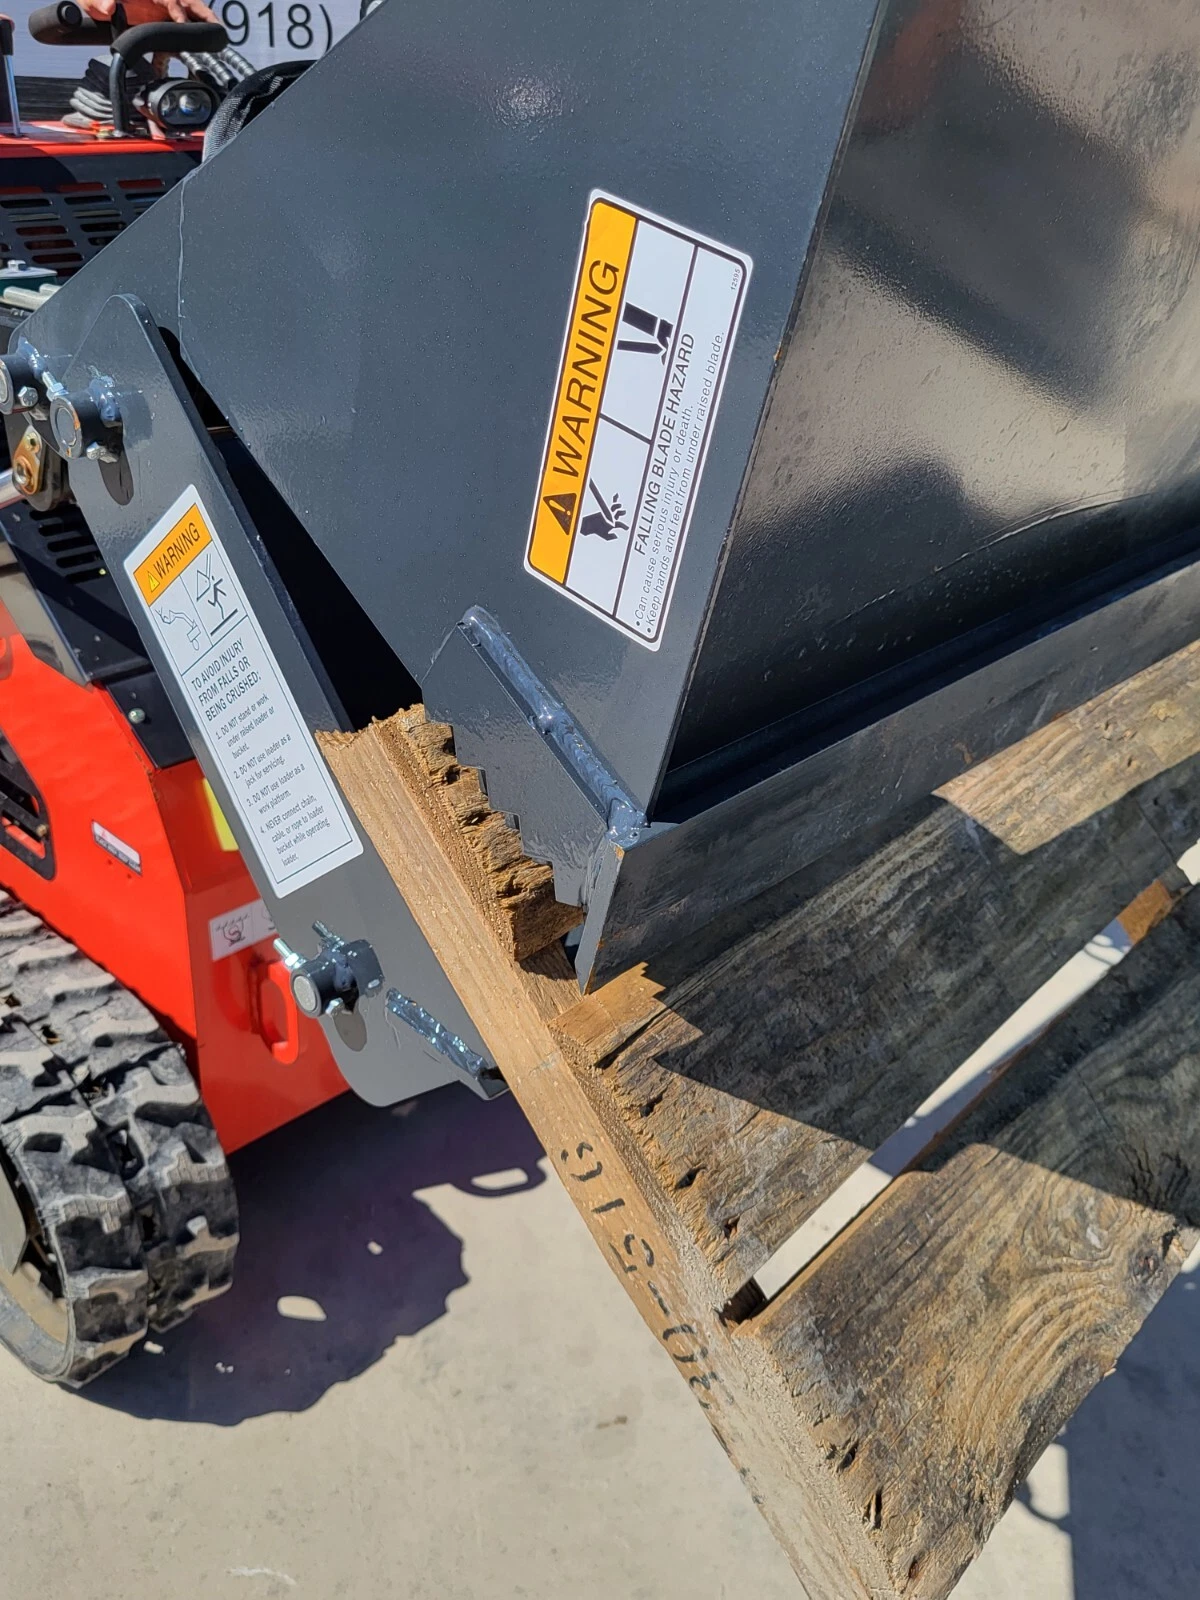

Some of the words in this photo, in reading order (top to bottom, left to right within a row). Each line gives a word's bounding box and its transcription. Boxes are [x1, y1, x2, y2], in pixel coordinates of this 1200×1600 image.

[208, 0, 332, 51] 918)
[730, 267, 740, 290] 12595
[552, 259, 619, 477] WARNING
[705, 332, 724, 374] blade.
[696, 377, 712, 421] raised
[675, 405, 693, 445] death.
[685, 423, 701, 463] under
[634, 481, 660, 555] FALLING
[651, 415, 675, 477] BLADE
[665, 333, 694, 413] HAZARD
[672, 448, 682, 463] or
[660, 466, 679, 505] injury
[675, 467, 691, 498] from
[651, 507, 668, 554] serious
[669, 500, 683, 525] feet
[153, 522, 200, 578] WARNING
[664, 527, 676, 552] and
[642, 557, 656, 593] cause
[653, 555, 670, 593] hands
[634, 596, 647, 619] Can
[645, 595, 661, 626] Keep
[190, 676, 202, 691] TO
[200, 659, 221, 684] AVOID
[219, 640, 244, 667] INJURY
[198, 682, 219, 706] FROM
[217, 665, 239, 690] FALLS
[237, 655, 251, 672] OR
[205, 697, 226, 721] BEING
[225, 671, 261, 704] CRUSHED:
[237, 706, 251, 722] stand
[255, 692, 269, 707] work
[226, 733, 240, 747] under
[239, 720, 254, 737] raised
[252, 710, 268, 726] loader
[264, 740, 281, 756] loader
[244, 774, 256, 789] jack
[259, 784, 271, 797] NOT
[277, 770, 294, 785] loader
[258, 802, 271, 814] work
[265, 814, 282, 830] NEVER
[281, 802, 301, 820] connect
[290, 819, 302, 830] rope
[306, 805, 324, 820] loader
[276, 839, 294, 854] bucket
[292, 832, 306, 844] while
[305, 817, 330, 837] operating
